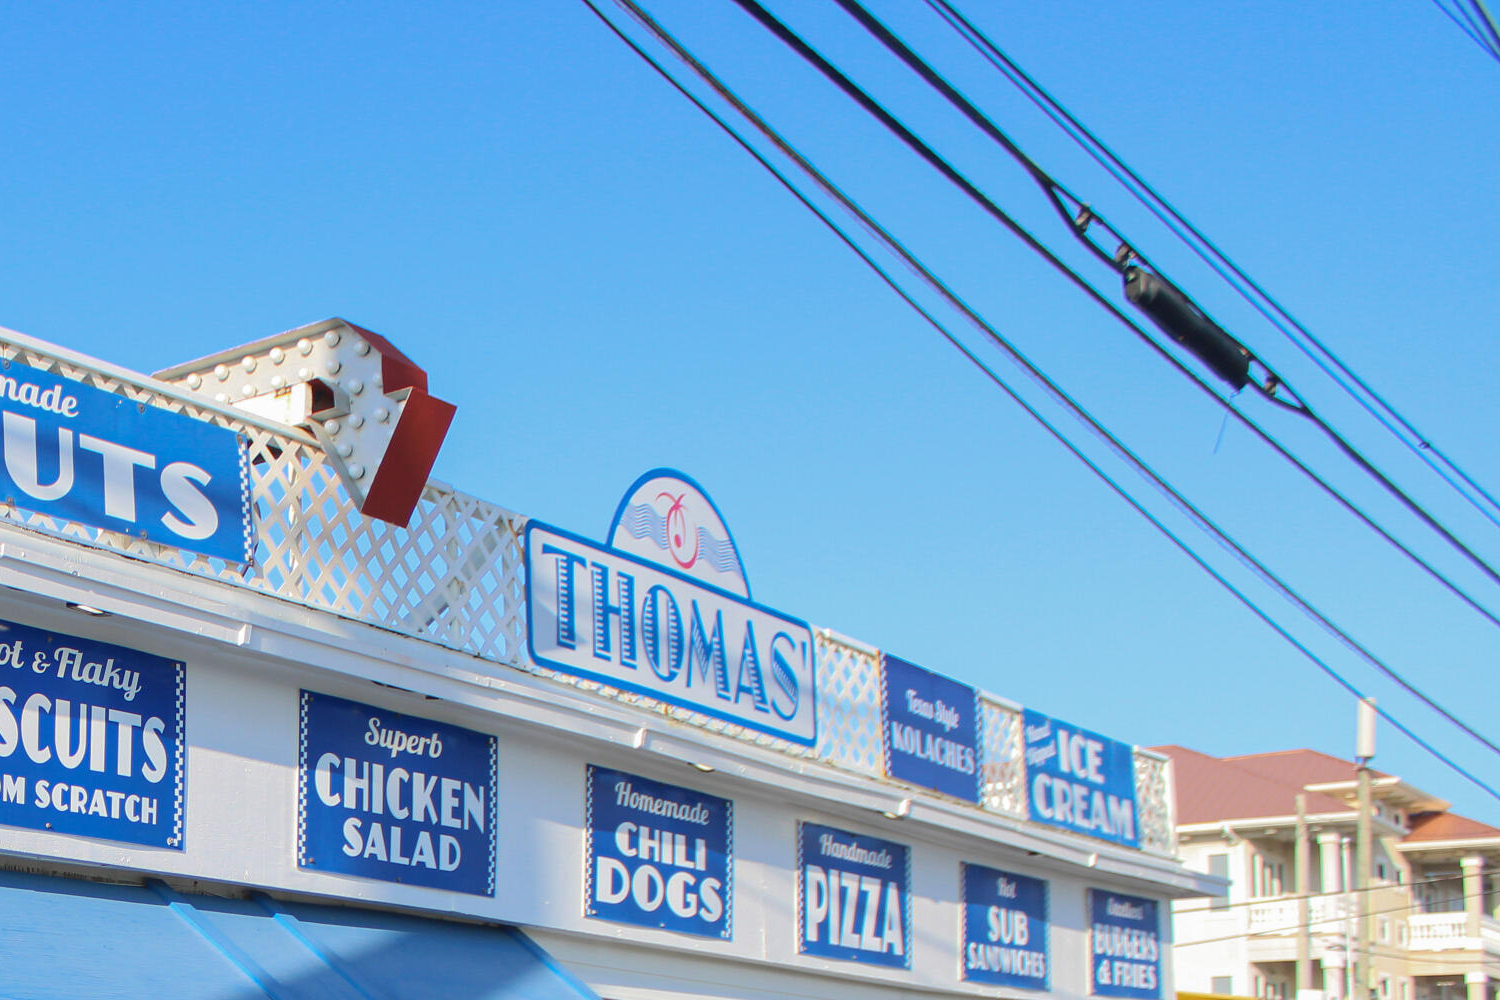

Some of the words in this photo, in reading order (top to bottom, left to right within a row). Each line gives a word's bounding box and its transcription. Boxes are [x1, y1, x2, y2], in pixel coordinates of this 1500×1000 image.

[32, 651, 51, 673] &
[54, 647, 141, 700] Flaky
[905, 689, 934, 720] Texas
[935, 700, 960, 732] Style
[365, 718, 442, 759] Superb
[891, 721, 975, 775] KOLACHES
[1057, 729, 1105, 784] ICE
[35, 780, 157, 825] SCRATCH
[315, 753, 485, 833] CHICKEN
[614, 781, 710, 825] Homemade
[1032, 773, 1136, 840] CREAM
[343, 818, 461, 872] SALAD
[615, 822, 706, 871] CHILI
[819, 834, 892, 868] Handmade
[596, 856, 723, 922] DOGS
[806, 864, 904, 955] PIZZA
[987, 905, 1029, 946] SUB
[1095, 923, 1158, 962] BURGERS
[967, 942, 1045, 978] SANDWICHES
[1097, 959, 1112, 985] &
[1113, 961, 1157, 989] FRIES
